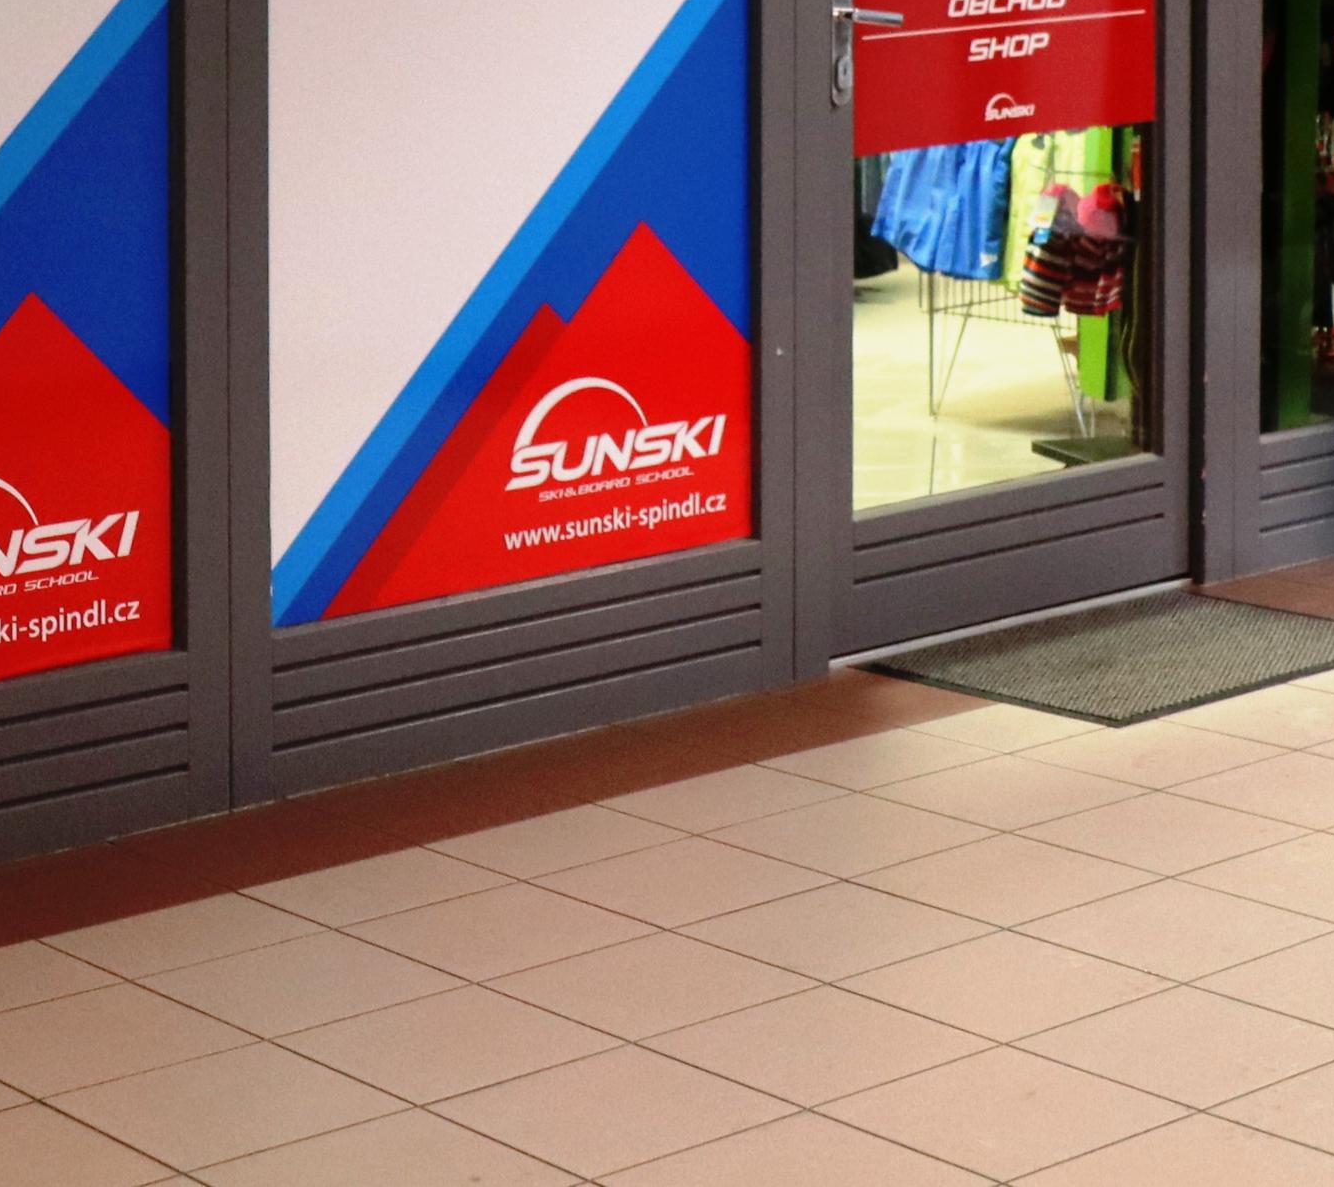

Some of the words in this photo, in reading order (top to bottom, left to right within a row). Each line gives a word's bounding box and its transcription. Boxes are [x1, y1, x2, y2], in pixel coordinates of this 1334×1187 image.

[968, 32, 1050, 62] SHOP
[505, 414, 727, 491] SUNSKI
[635, 466, 695, 486] SCHOOL
[504, 492, 727, 551] www.sunski-spindl.cz
[23, 570, 100, 593] SCHOOL
